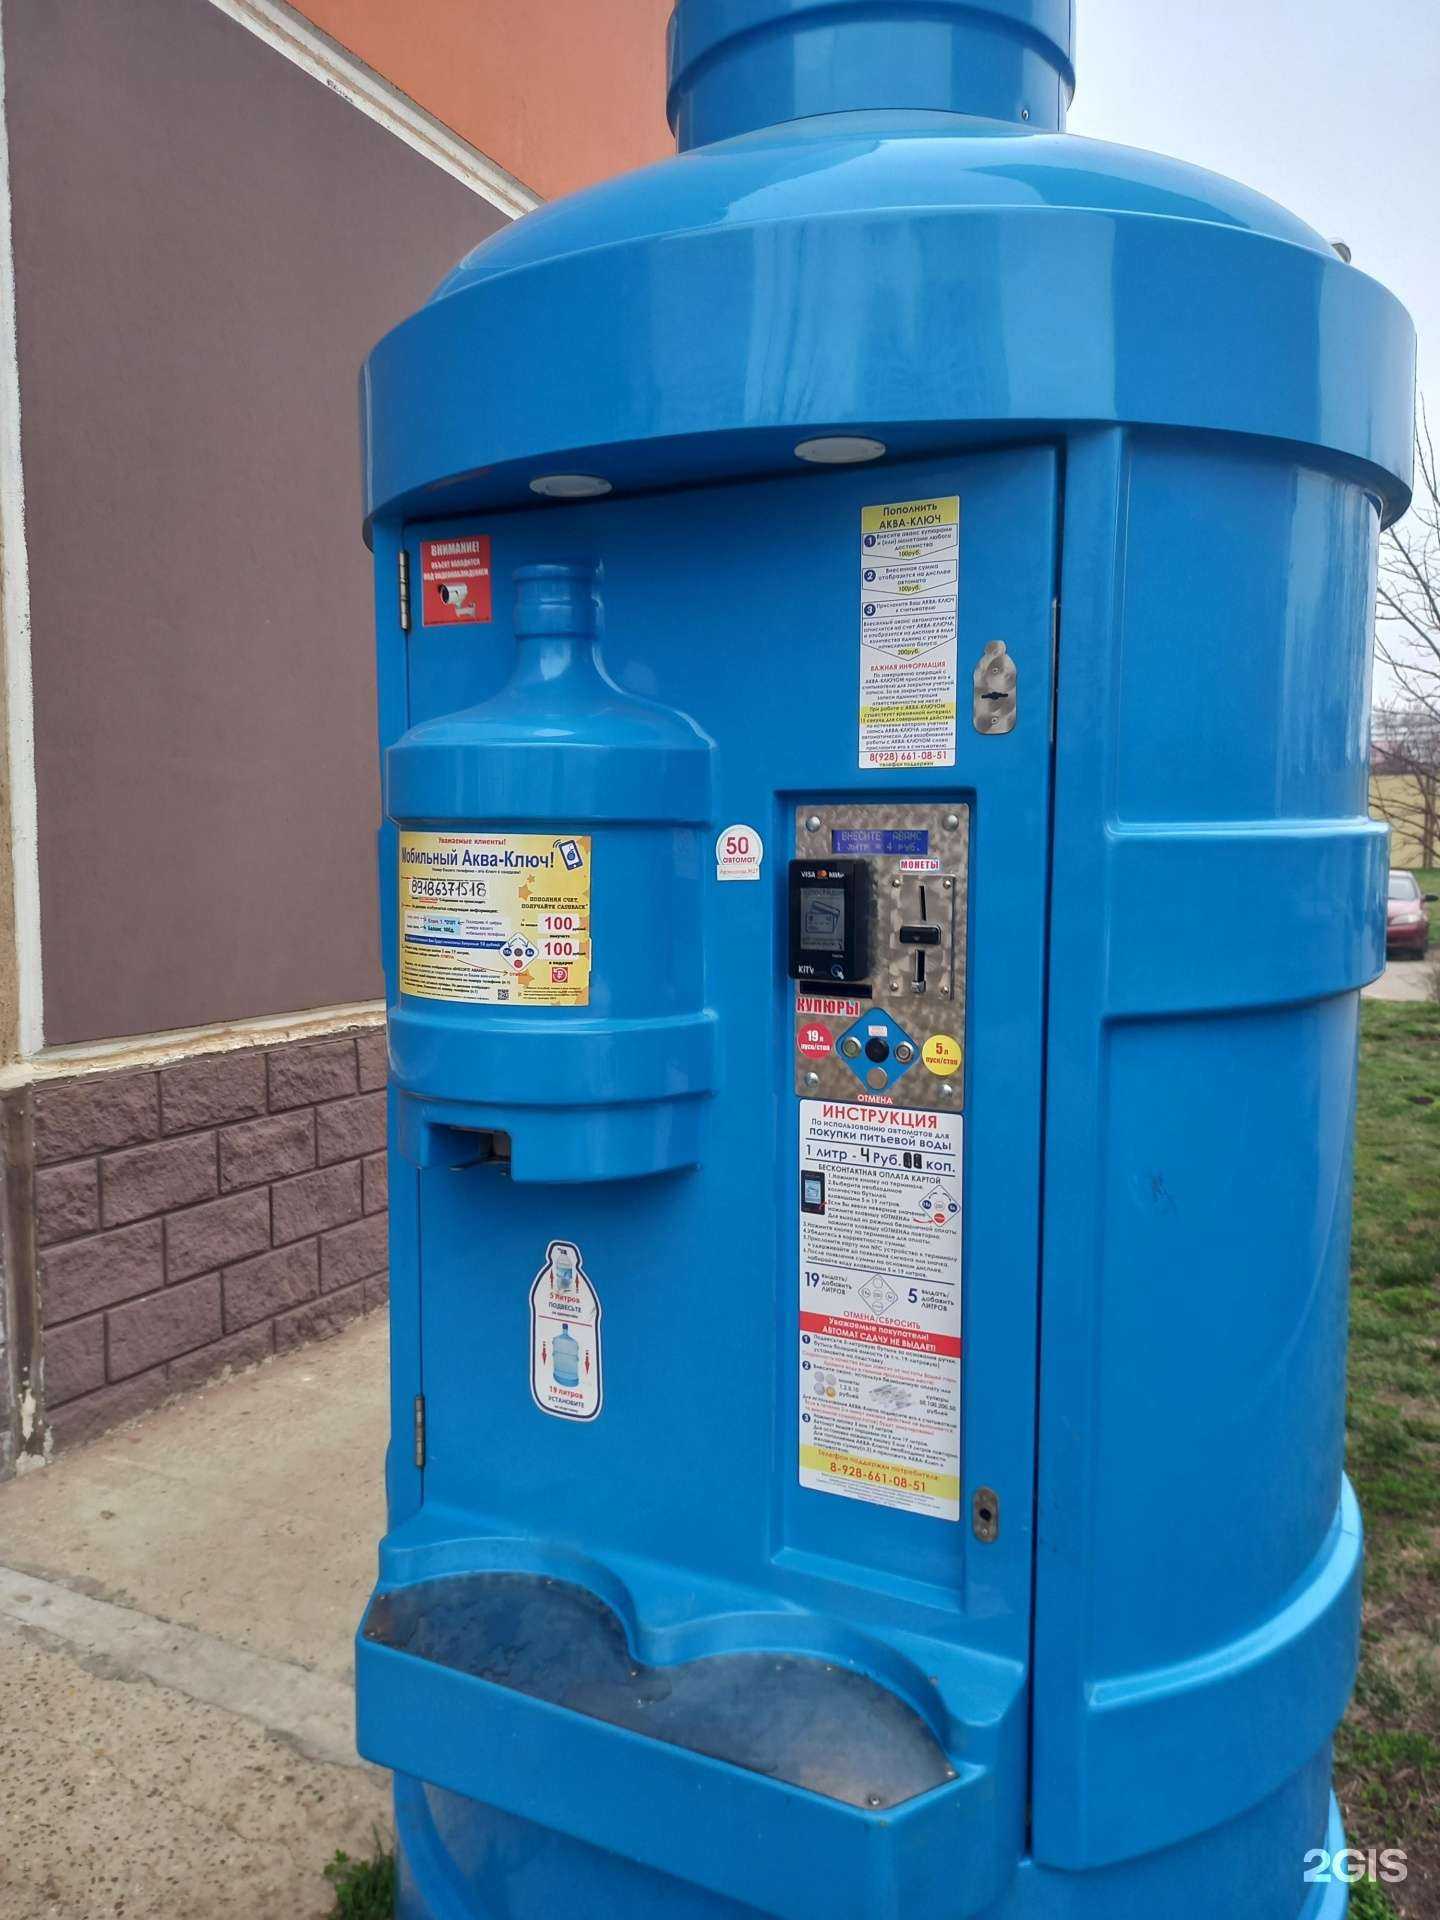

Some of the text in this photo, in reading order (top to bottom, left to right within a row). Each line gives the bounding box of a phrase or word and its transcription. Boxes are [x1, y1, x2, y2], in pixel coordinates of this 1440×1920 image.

[883, 504, 938, 516] Пополнить
[879, 515, 941, 530] АКВА-КЛЮЧ
[431, 541, 480, 556] ВНИМАНИЕ!
[899, 661, 946, 670] ИНФОРМАЦИЯ
[869, 751, 947, 763] 8(928) 661-08-51
[726, 836, 749, 855] 50
[401, 848, 555, 869] Мобильный Аква-Ключ!
[901, 860, 939, 869] МОНЕТЫ
[544, 917, 573, 930] 100
[544, 942, 573, 956] 100
[797, 998, 859, 1015] КУПЮРЫ
[807, 1030, 819, 1042] 19
[936, 1042, 943, 1055] 5
[857, 1094, 893, 1105] ОТМЕНА
[822, 1105, 938, 1129] ИНСТРУКЦИЯ
[823, 1121, 886, 1134] использованию
[887, 1128, 933, 1138] автоматов
[935, 1132, 950, 1140] для
[809, 1127, 952, 1151] покупки питьевой воды
[806, 1144, 812, 1156] 1
[816, 1148, 848, 1162] литр
[860, 1148, 870, 1163] 4
[818, 1163, 941, 1184] БЕСКОНТАКТНАЯ ОПЛАТА КАРТОЙ
[926, 1160, 956, 1173] коп.
[804, 1272, 820, 1288] 19
[821, 1280, 853, 1290] добавить
[554, 1292, 581, 1304] литров
[908, 1288, 918, 1304] 5
[921, 1297, 955, 1306] добавить
[549, 1302, 582, 1313] ПОДВЕСЬТЕ
[843, 1310, 921, 1329] ОТМЕНА/СБРОСИТЬ
[828, 1318, 929, 1341] Уважаемые покупатели!
[822, 1326, 936, 1352] АВТОМАТ СДАЧУ НЕ ВЫДАЕТ!
[559, 1388, 583, 1400] литров
[548, 1396, 585, 1409] УСТАНОВИТЕ
[830, 1462, 926, 1492] 8-928-661-08-51
